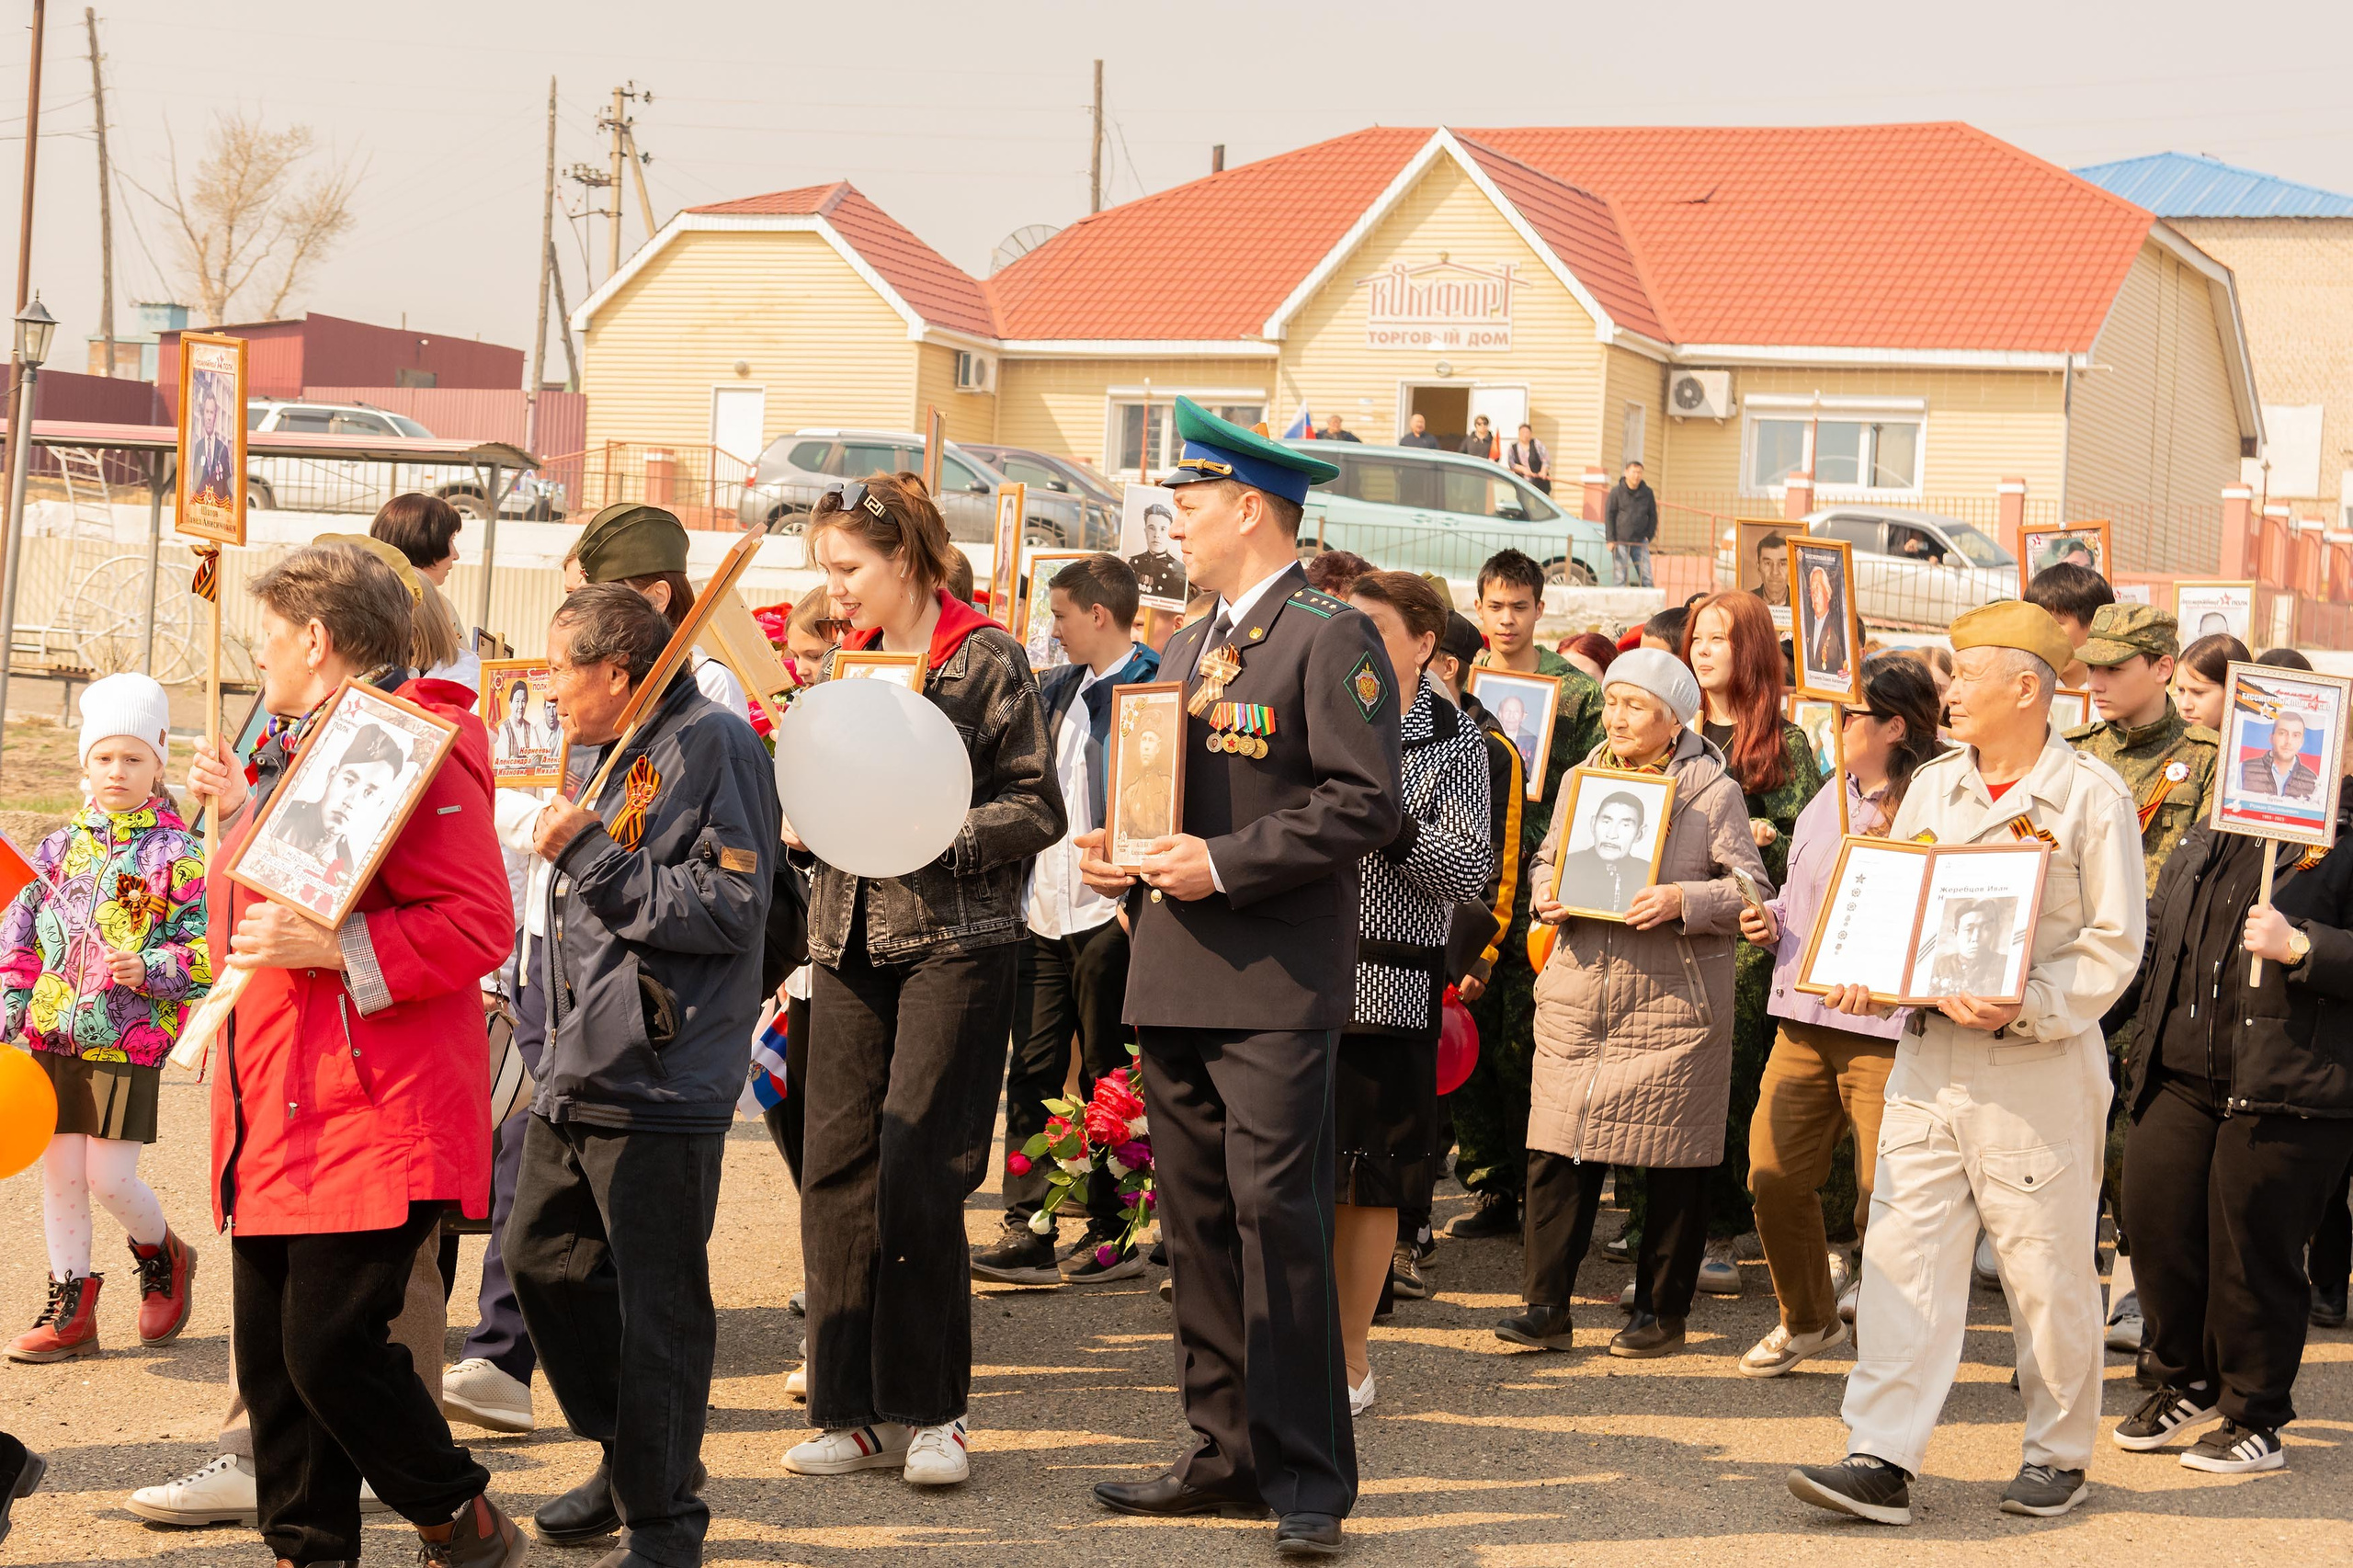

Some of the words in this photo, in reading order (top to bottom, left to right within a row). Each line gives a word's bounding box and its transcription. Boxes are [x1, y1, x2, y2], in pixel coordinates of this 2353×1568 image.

[1468, 331, 1509, 347] ДОМ
[200, 506, 219, 517] Шатов
[532, 683, 548, 691] ПОЛК
[332, 721, 349, 733] ПОЛК
[519, 746, 551, 756] Корнеевы
[494, 757, 532, 766] Александра
[497, 768, 528, 777] Ивановна
[286, 850, 326, 873] Нарышкин
[260, 852, 294, 873] Василий
[293, 868, 339, 894] Гаврилович
[1939, 885, 1984, 894] Жеребцов
